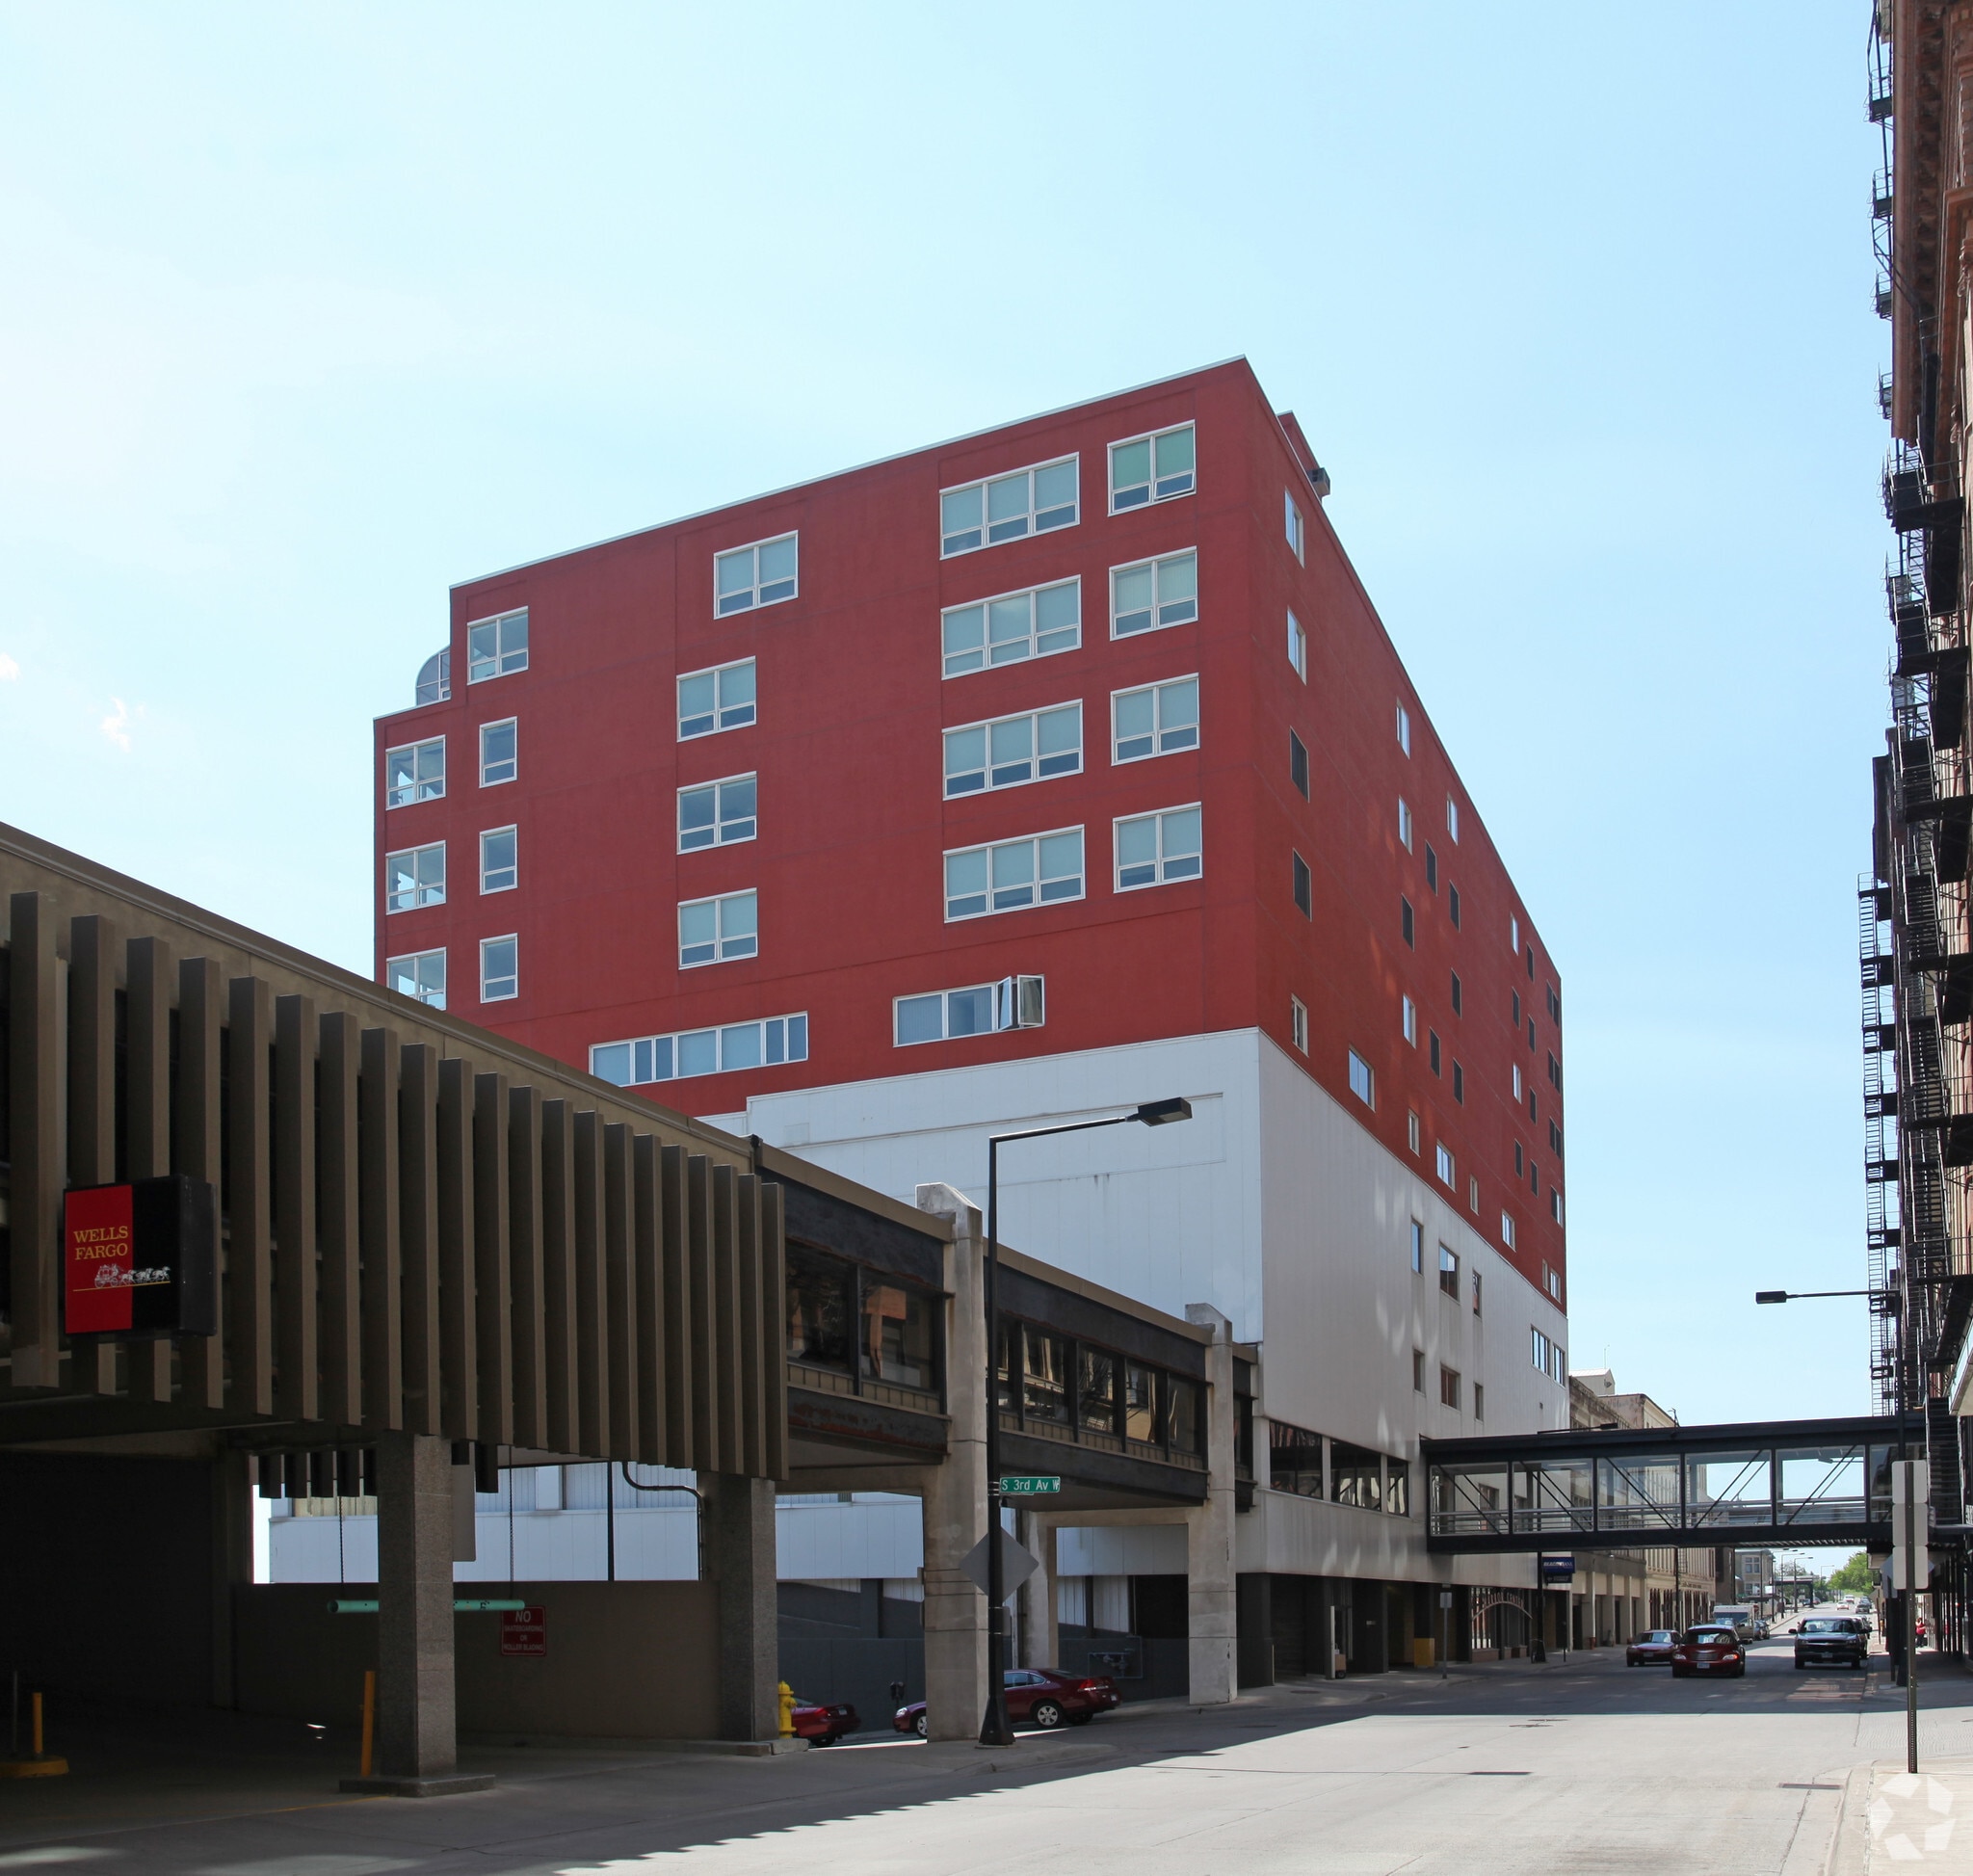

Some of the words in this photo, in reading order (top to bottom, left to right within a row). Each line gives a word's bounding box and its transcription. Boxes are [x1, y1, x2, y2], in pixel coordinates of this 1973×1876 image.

[73, 1226, 129, 1243] WELLS
[74, 1243, 129, 1260] FARGO
[1001, 1479, 1009, 1491] S
[1013, 1479, 1031, 1491] 3rd
[1036, 1479, 1049, 1491] Av
[515, 1610, 532, 1623] NO
